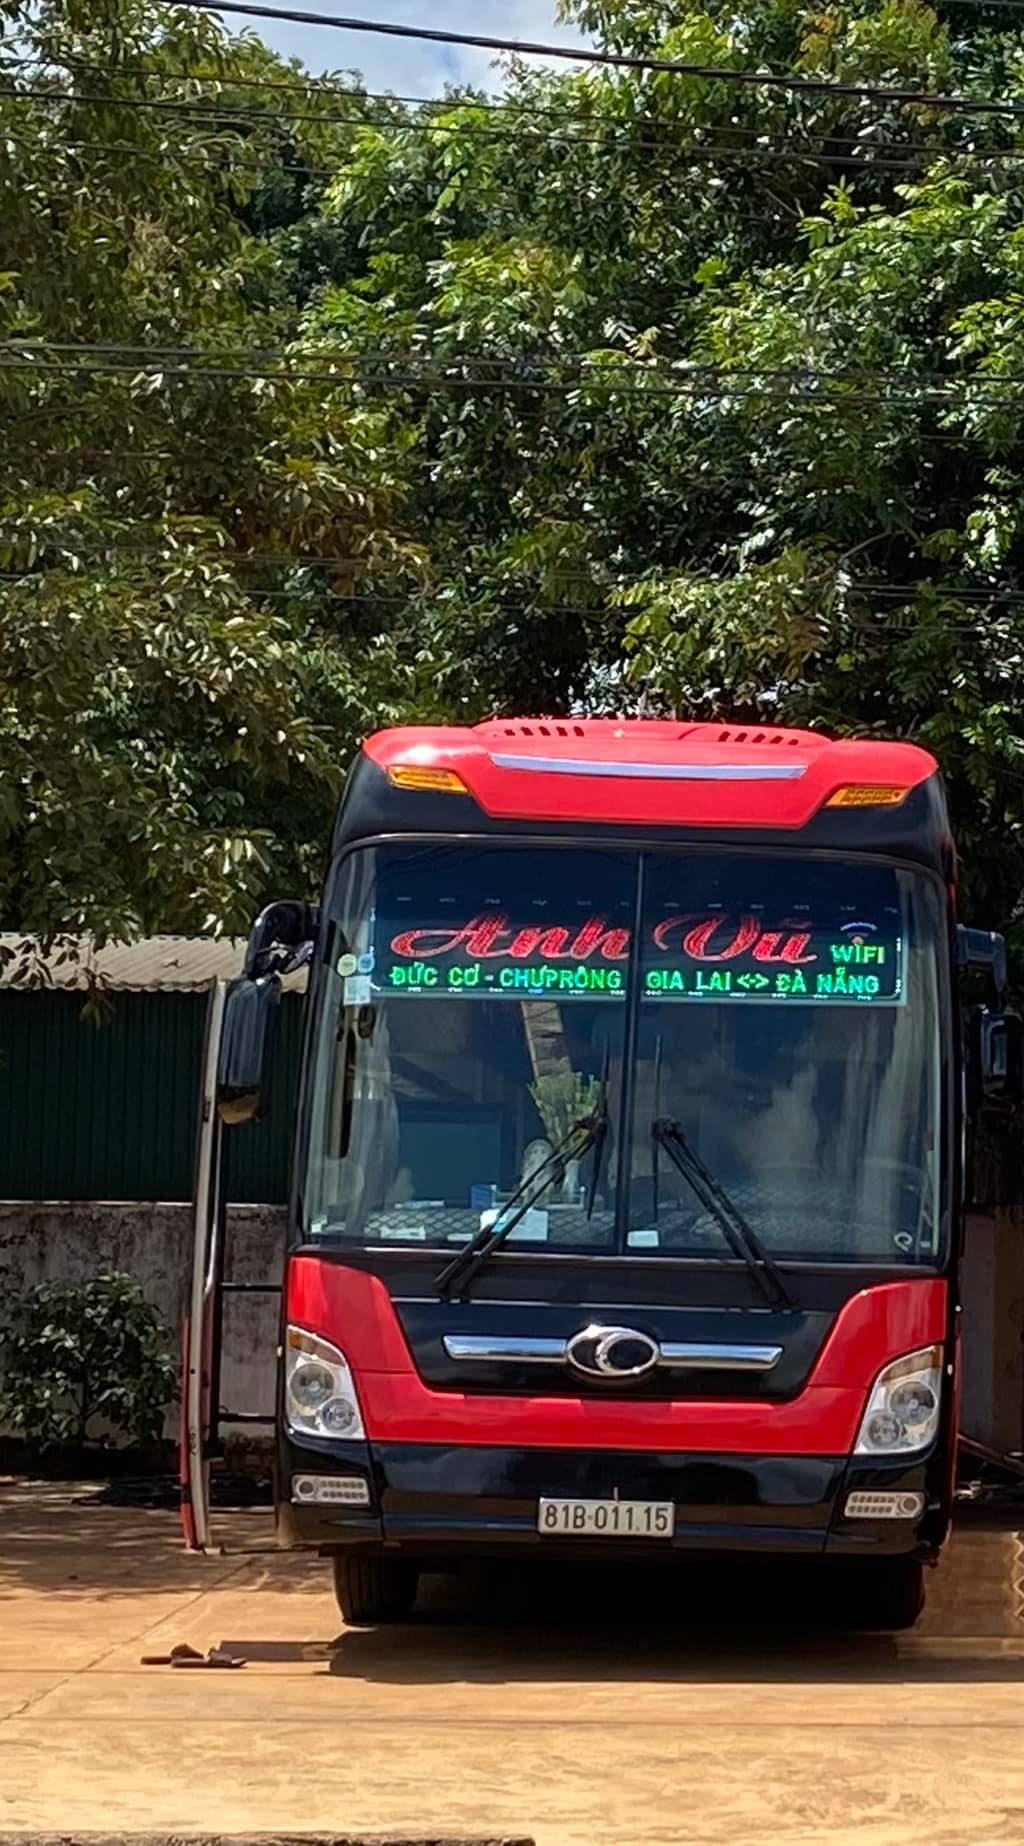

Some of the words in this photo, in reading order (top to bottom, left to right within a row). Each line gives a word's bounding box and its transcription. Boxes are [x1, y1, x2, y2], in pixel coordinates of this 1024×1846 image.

[390, 914, 630, 960] Anh
[653, 914, 818, 963] Vũ
[390, 962, 438, 987] ĐỨC
[646, 970, 684, 990] GIA
[696, 971, 731, 991] LAI
[775, 969, 807, 992] ĐÀ
[545, 1503, 668, 1532] 81B-011.15
